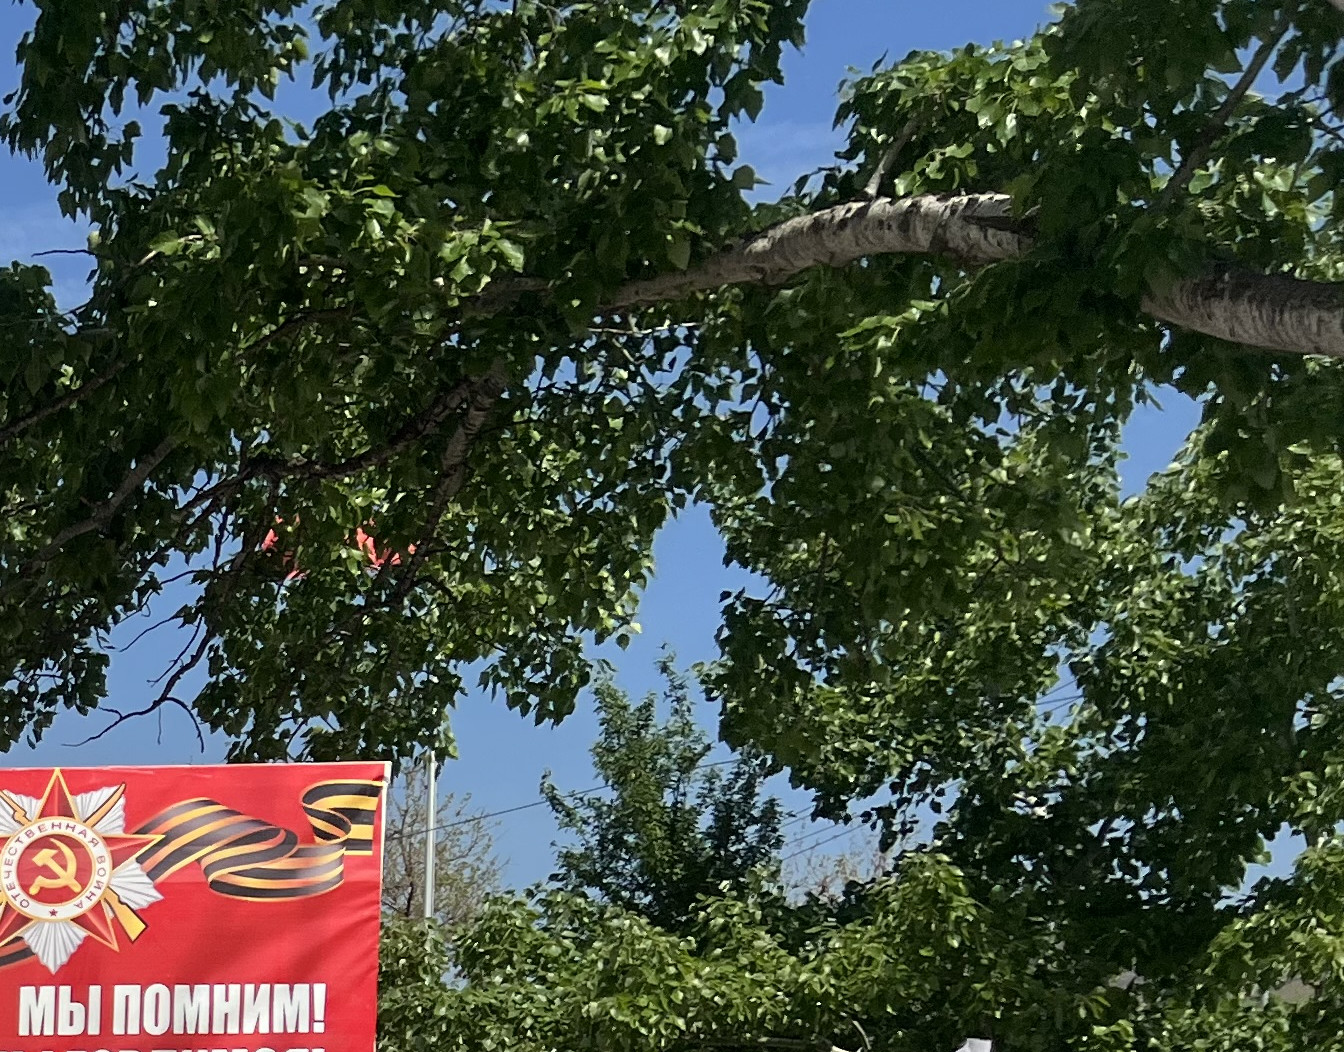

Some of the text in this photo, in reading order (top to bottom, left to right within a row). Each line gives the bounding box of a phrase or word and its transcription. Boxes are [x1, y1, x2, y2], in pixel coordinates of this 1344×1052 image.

[3, 821, 100, 909] ОТЕЧЕСТВЕННАЯ
[18, 982, 327, 1037] МЫ ПОМНИМ!
